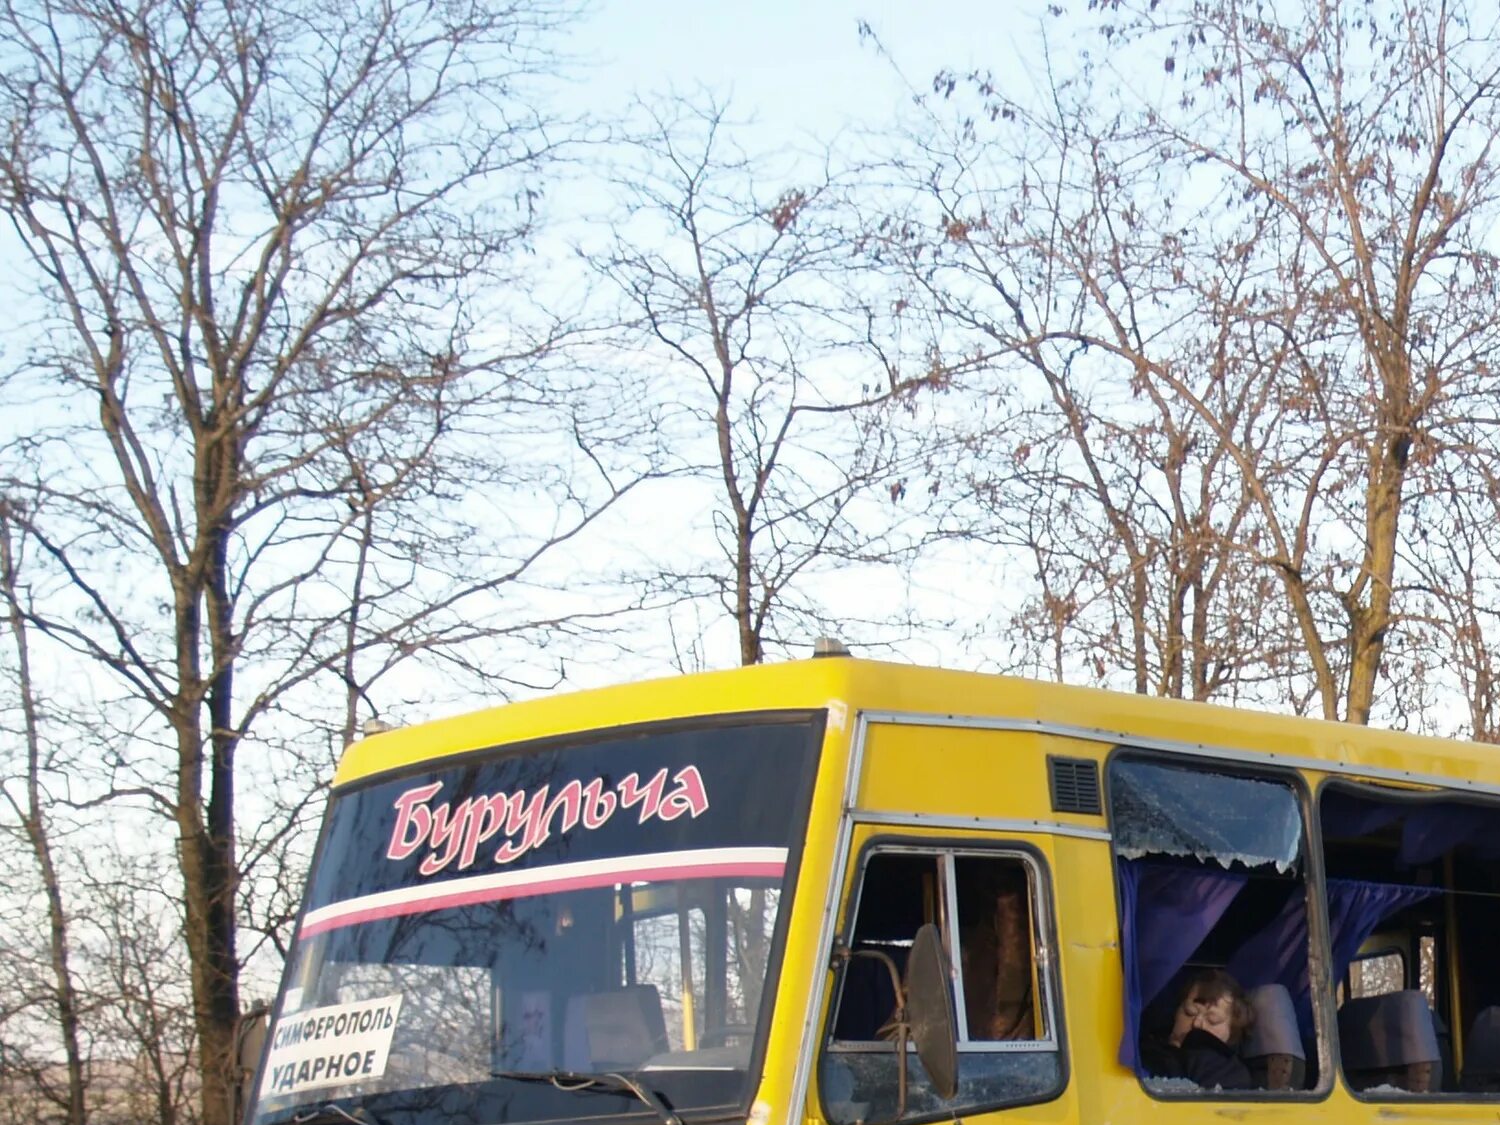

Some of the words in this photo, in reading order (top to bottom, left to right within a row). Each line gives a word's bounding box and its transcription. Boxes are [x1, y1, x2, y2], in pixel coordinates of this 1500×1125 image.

[387, 765, 709, 875] Бурульча
[273, 1006, 394, 1050] СИМФЕРОПОЛЬ
[271, 1050, 376, 1092] УДАРНОЕ
